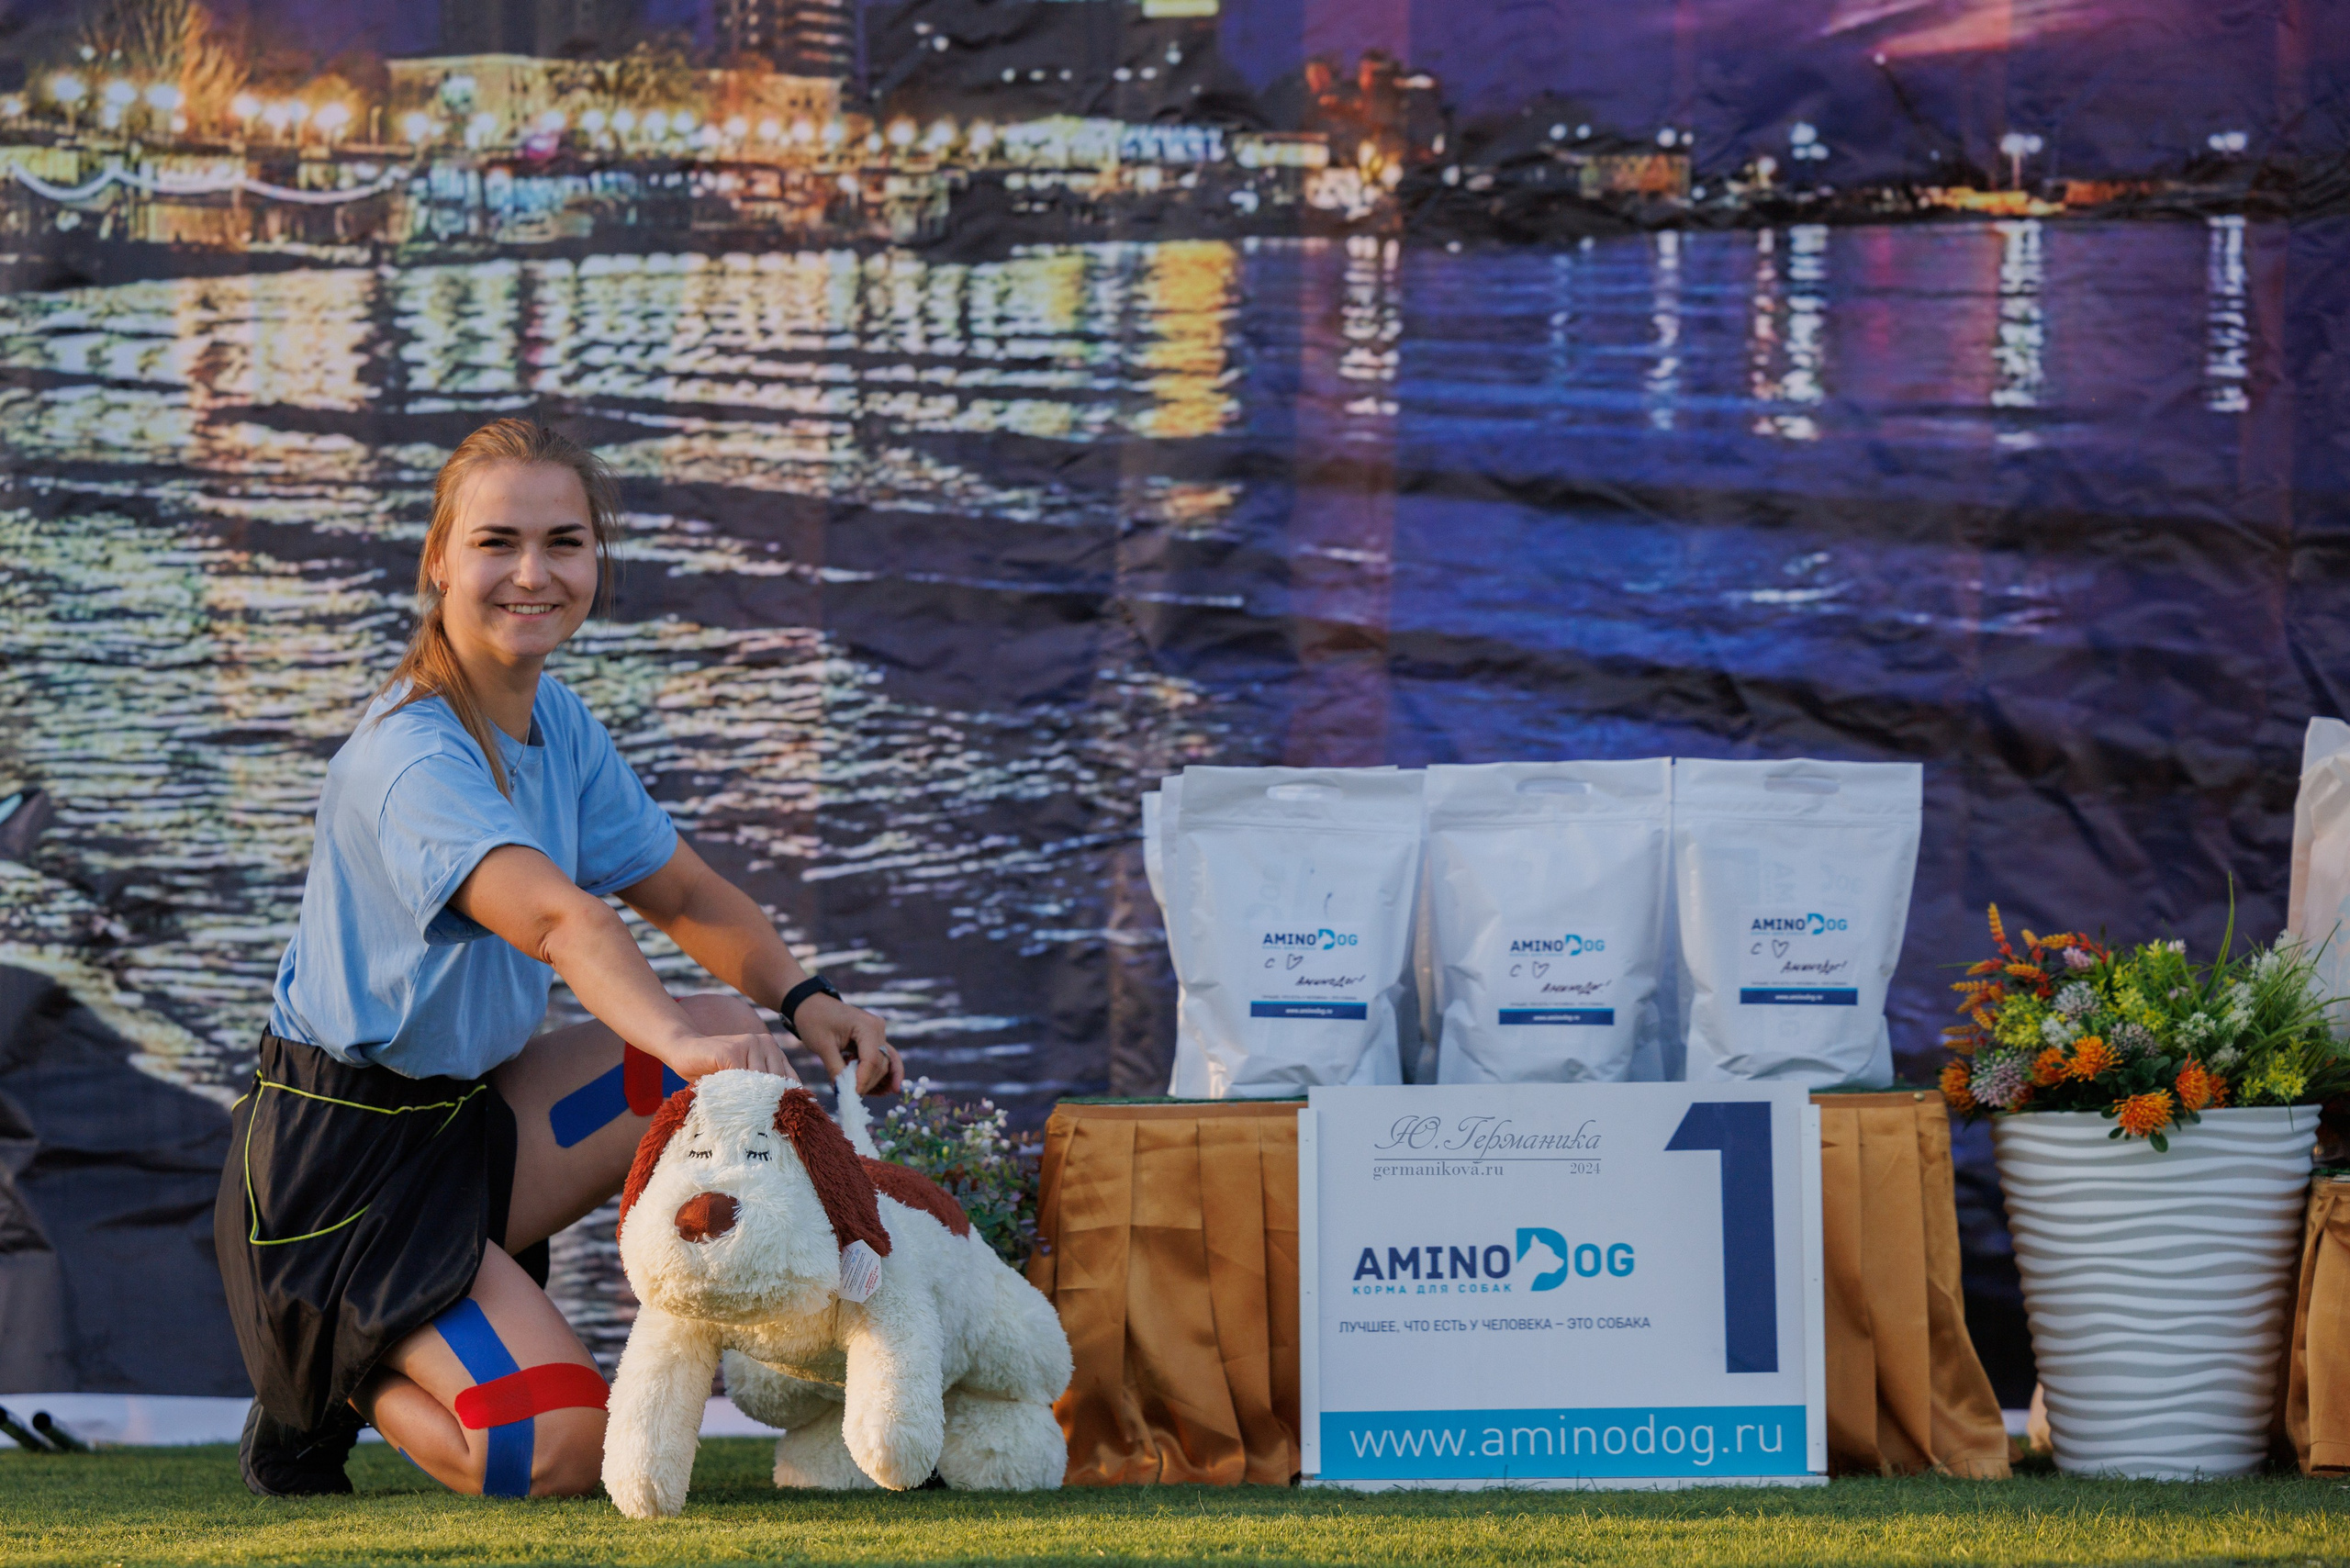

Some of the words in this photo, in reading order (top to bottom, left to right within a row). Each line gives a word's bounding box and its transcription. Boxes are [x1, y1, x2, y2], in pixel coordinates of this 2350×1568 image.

[1751, 913, 1848, 935] AMINODOG
[1262, 928, 1359, 950] AMINODOG
[1509, 934, 1606, 957] AMINODOG
[1663, 1101, 1779, 1373] 1
[1353, 1227, 1635, 1292] AMINODOG
[1352, 1284, 1407, 1295] КОРМА
[1416, 1283, 1449, 1295] ДЛЯ
[1459, 1283, 1513, 1294] СОБАК
[1339, 1321, 1400, 1334] ЛУЧШЕЕ,
[1404, 1320, 1430, 1332] ЧТО
[1434, 1319, 1467, 1332] ЕСТЬ
[1468, 1319, 1479, 1331] У
[1482, 1318, 1553, 1331] ЧЕЛОВЕКА
[1567, 1317, 1594, 1330] ЭТО
[1596, 1317, 1651, 1330] СОБАКА
[1348, 1414, 1784, 1466] www.aminodog.ru
